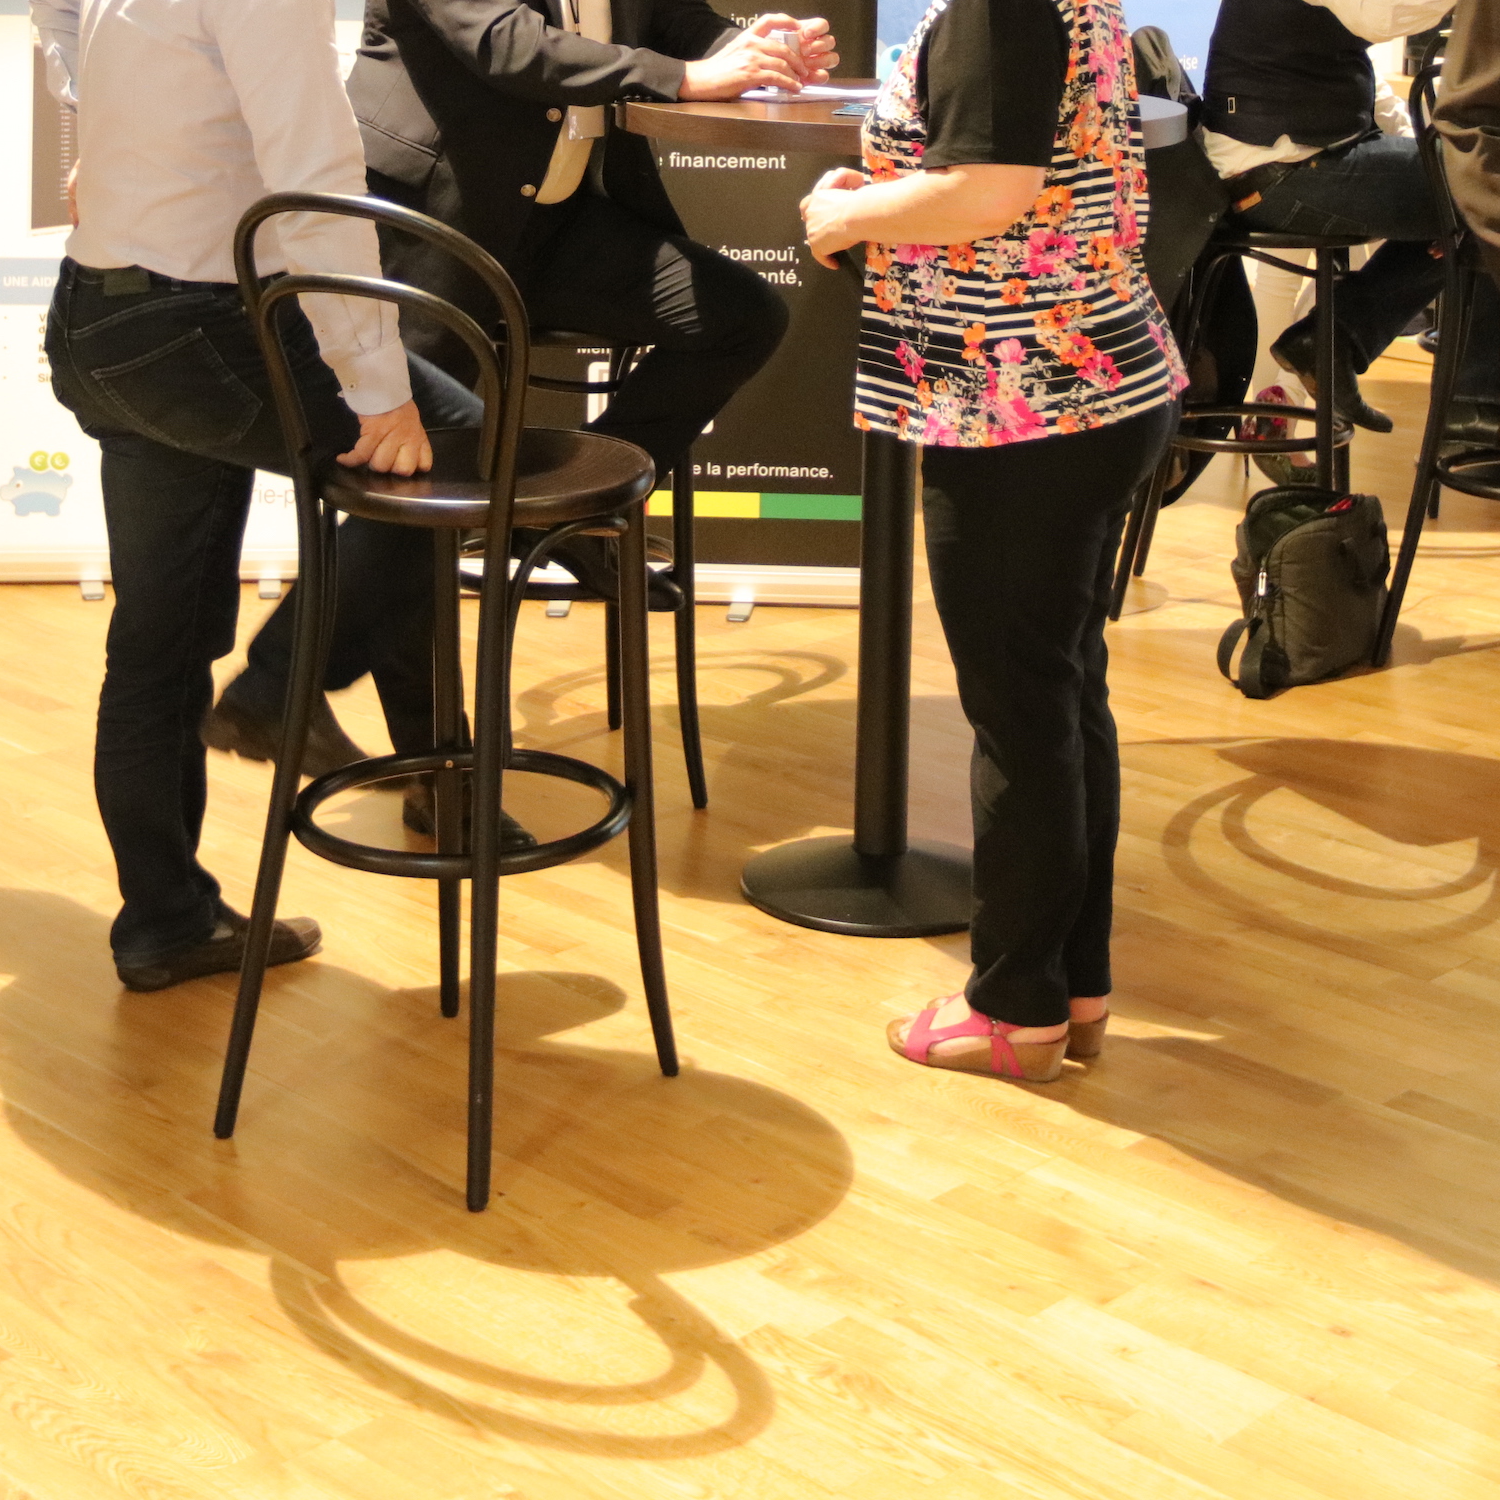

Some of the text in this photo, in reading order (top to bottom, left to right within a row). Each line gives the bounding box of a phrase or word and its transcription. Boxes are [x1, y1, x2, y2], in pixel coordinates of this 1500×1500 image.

[669, 152, 786, 169] financement
[3, 276, 28, 287] UNE
[707, 462, 721, 475] la
[726, 462, 834, 479] performance.
